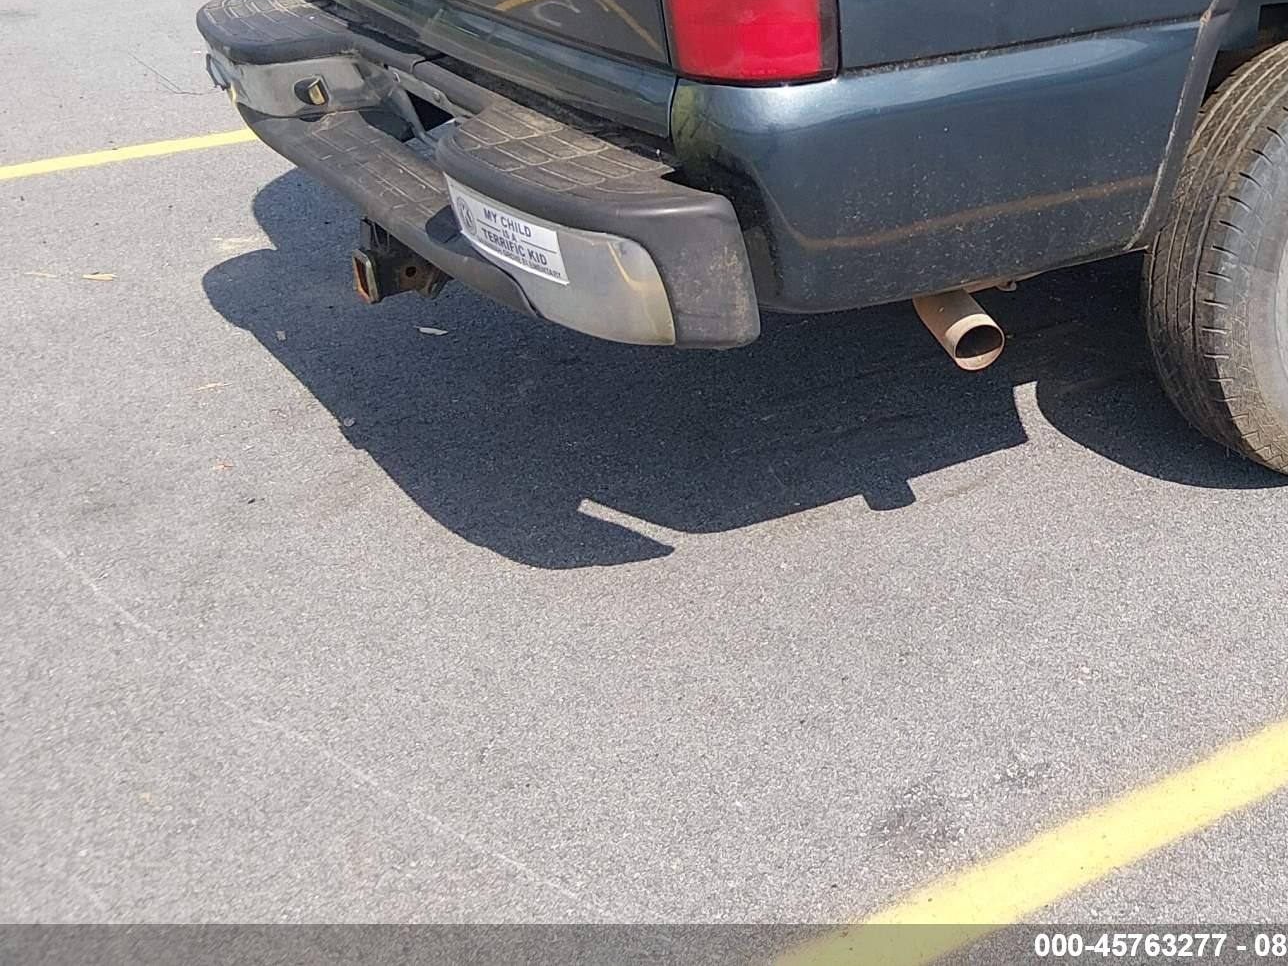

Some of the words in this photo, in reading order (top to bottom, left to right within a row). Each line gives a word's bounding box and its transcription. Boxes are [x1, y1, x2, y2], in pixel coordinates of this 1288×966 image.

[484, 208, 497, 223] MY
[501, 217, 532, 237] CHILD
[502, 230, 511, 240] IS
[512, 233, 518, 242] A
[482, 227, 525, 257] TERRIFIC
[528, 248, 547, 265] KID
